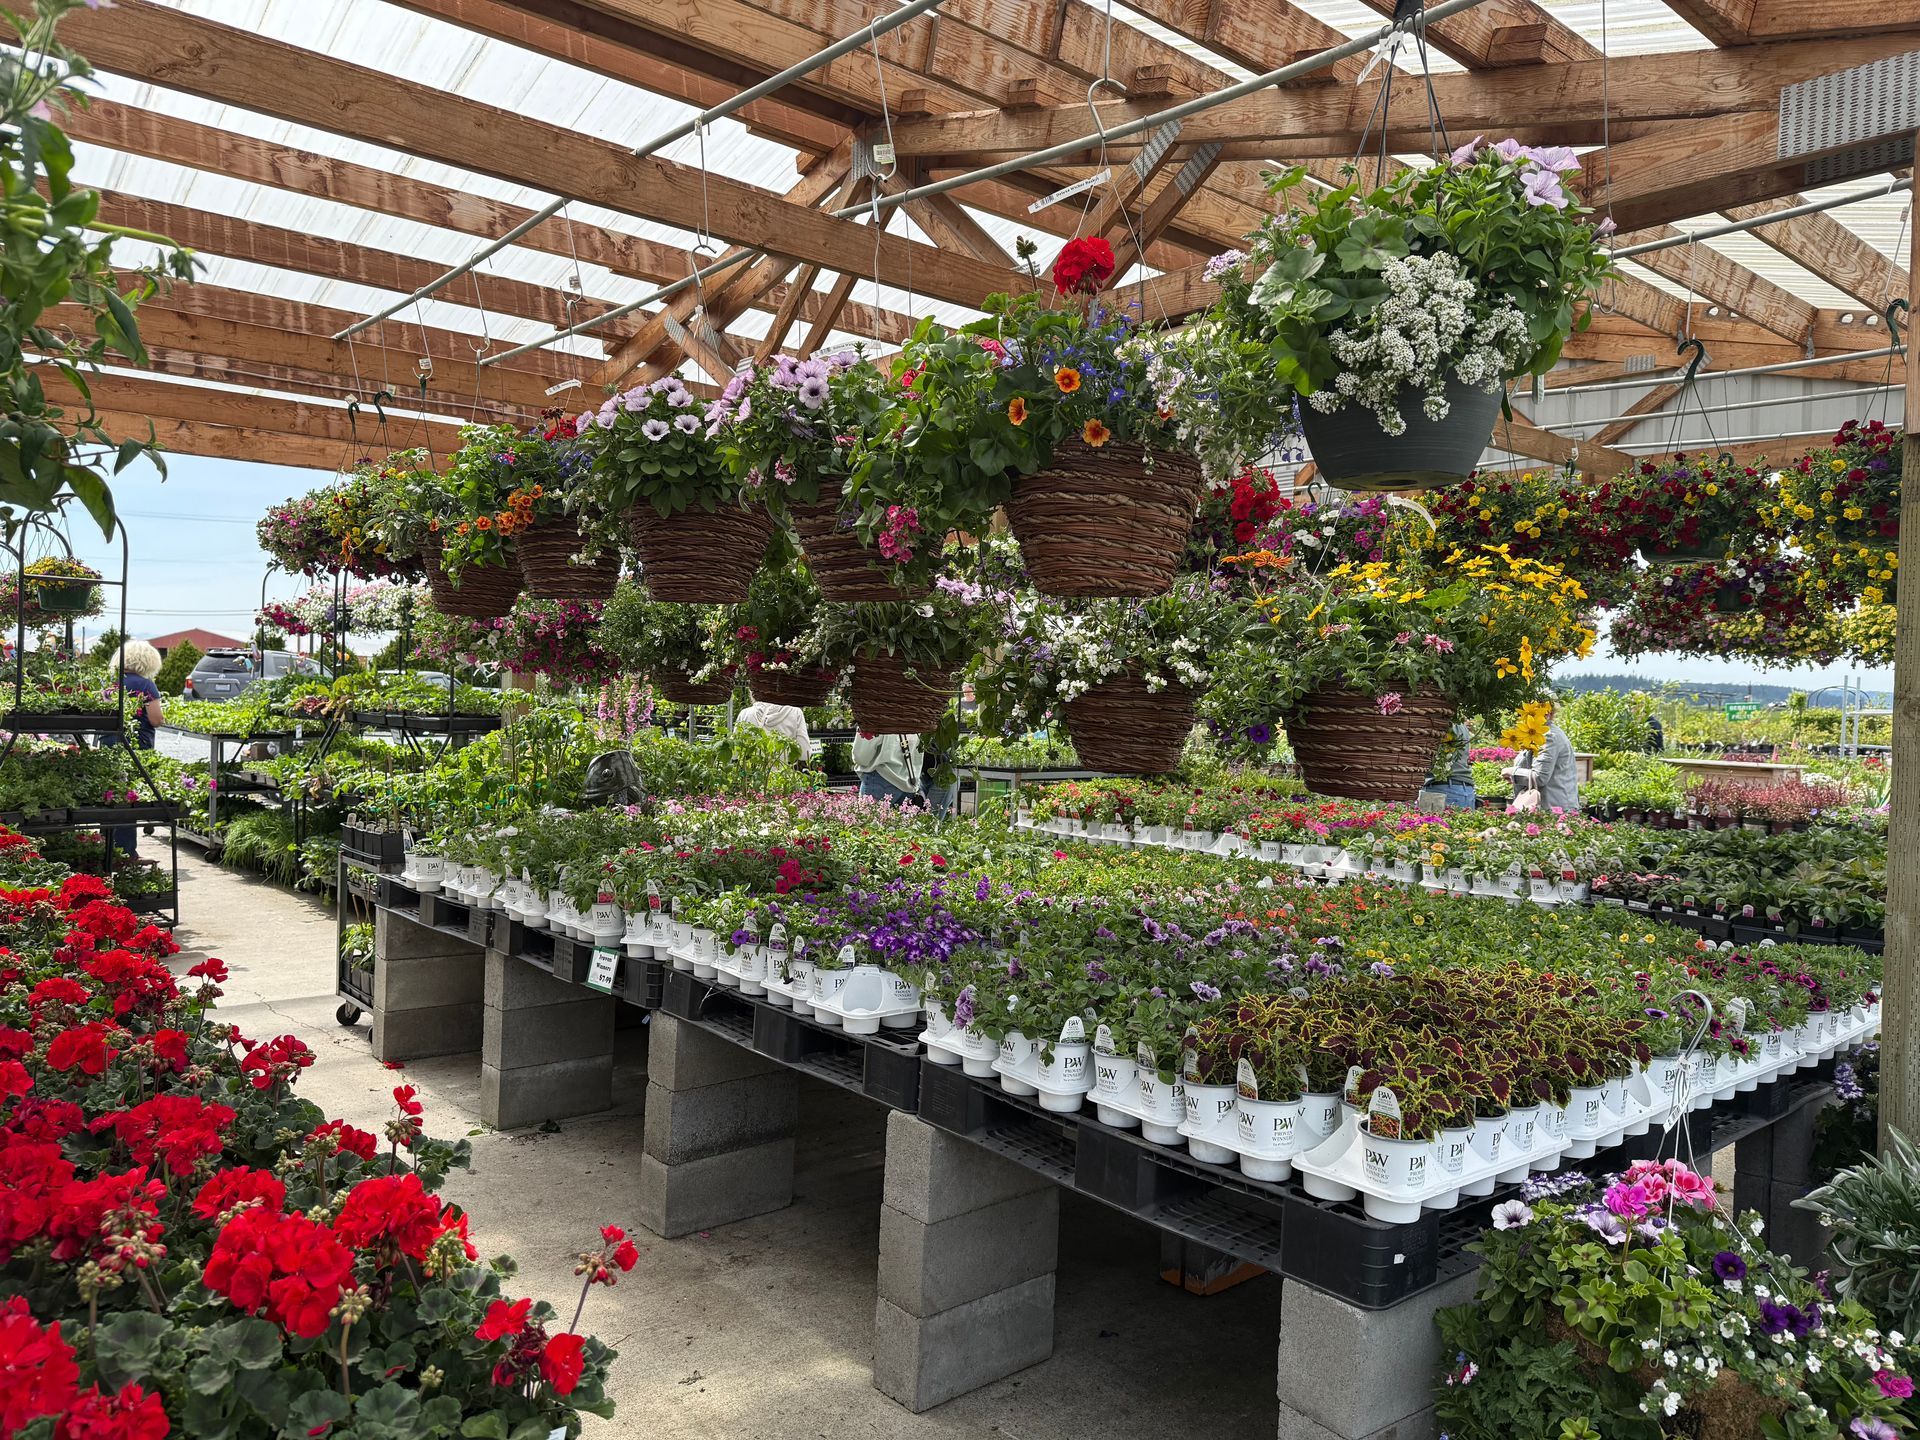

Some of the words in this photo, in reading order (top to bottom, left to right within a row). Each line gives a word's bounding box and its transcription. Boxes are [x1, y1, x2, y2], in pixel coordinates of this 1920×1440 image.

[596, 962, 612, 972] Winners
[598, 974, 612, 984] $7.99
[895, 981, 912, 990] PW
[1064, 1056, 1084, 1068] PW
[1098, 1066, 1118, 1080] PW
[1378, 1091, 1392, 1100] PW
[1274, 1116, 1296, 1130] PW
[1364, 1148, 1389, 1167] PW
[1366, 1163, 1386, 1173] PROVEN
